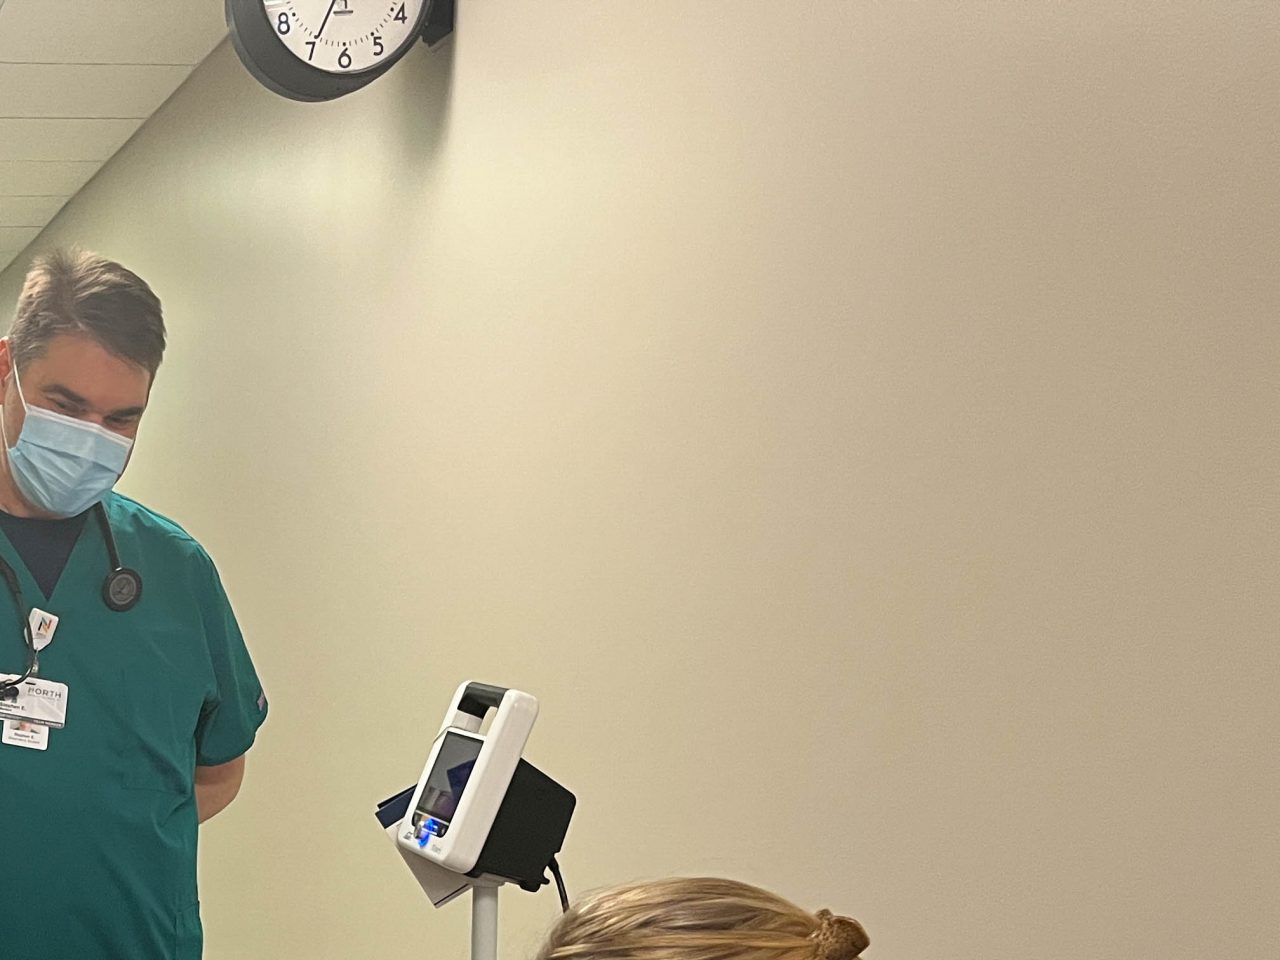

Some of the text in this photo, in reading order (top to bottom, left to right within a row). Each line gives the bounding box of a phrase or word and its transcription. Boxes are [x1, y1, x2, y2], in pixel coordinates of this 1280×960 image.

[277, 12, 290, 35] 8
[394, 3, 407, 24] 4
[305, 41, 316, 61] 7
[373, 37, 383, 56] 5
[338, 48, 352, 68] 6
